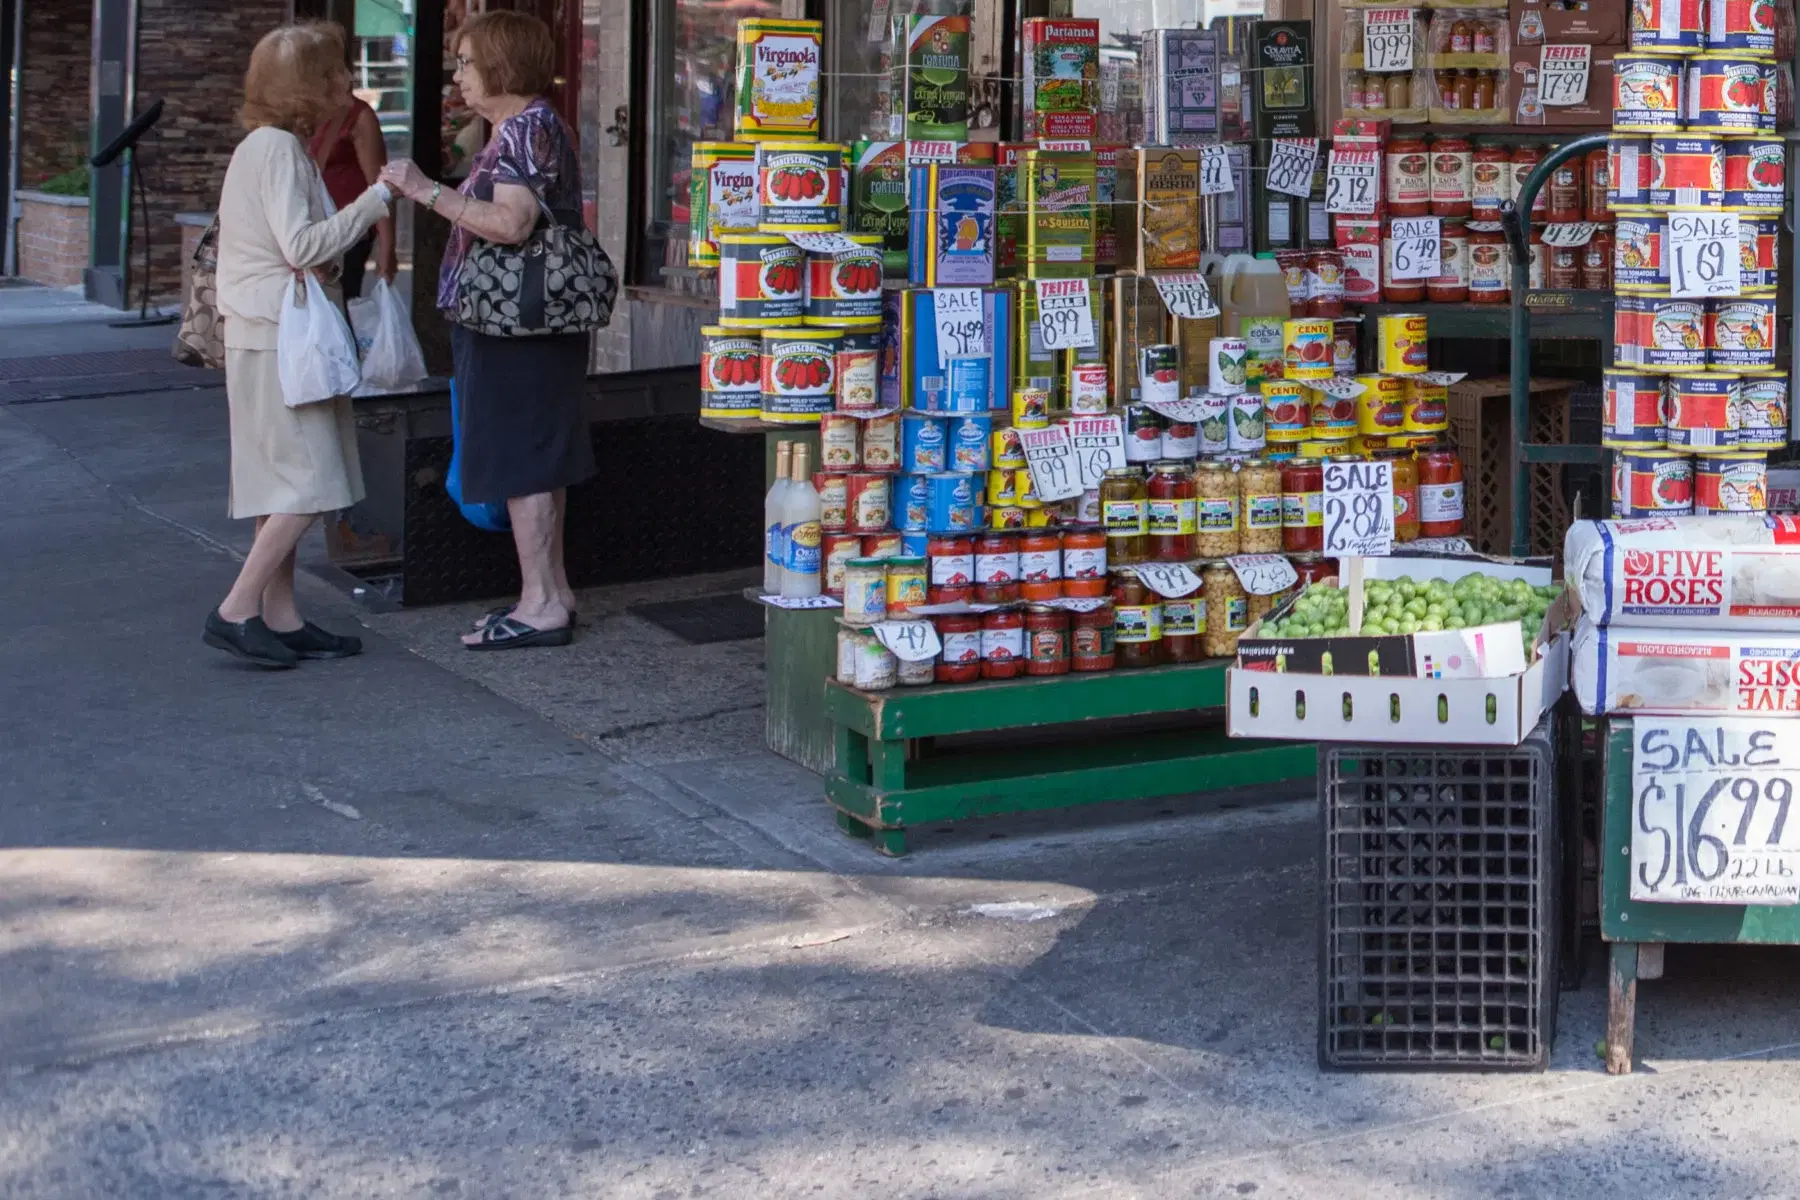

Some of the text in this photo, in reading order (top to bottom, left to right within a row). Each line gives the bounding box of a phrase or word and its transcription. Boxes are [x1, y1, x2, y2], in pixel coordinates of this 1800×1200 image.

[1367, 9, 1409, 23] TEITEL
[1045, 26, 1095, 40] Partanna
[758, 46, 816, 65] Virginola
[1366, 35, 1411, 69] 19.99
[1544, 46, 1587, 60] TEITEL
[1038, 219, 1048, 227] LA
[1392, 221, 1436, 239] SALE
[1671, 217, 1736, 240] SALE
[1395, 238, 1437, 272] 6.49
[1675, 241, 1725, 292] 1.69
[1041, 280, 1085, 298] TEITEL
[938, 290, 979, 308] SALE
[1042, 308, 1080, 346] 8.99
[1299, 325, 1329, 333] CENTO
[1271, 386, 1302, 395] CENTO
[1325, 463, 1388, 491] SALE
[1654, 550, 1722, 577] FIVE
[1623, 578, 1723, 606] ROSES
[1632, 607, 1711, 615] ALL PURPOSE ENRICHED
[1749, 607, 1791, 618] BLEACHED
[1636, 644, 1712, 657] FLOUR BLEACHED
[1738, 688, 1800, 711] FIVE
[1641, 728, 1781, 769] SALE
[1637, 774, 1793, 894] $16.99
[1730, 858, 1760, 880] 22
